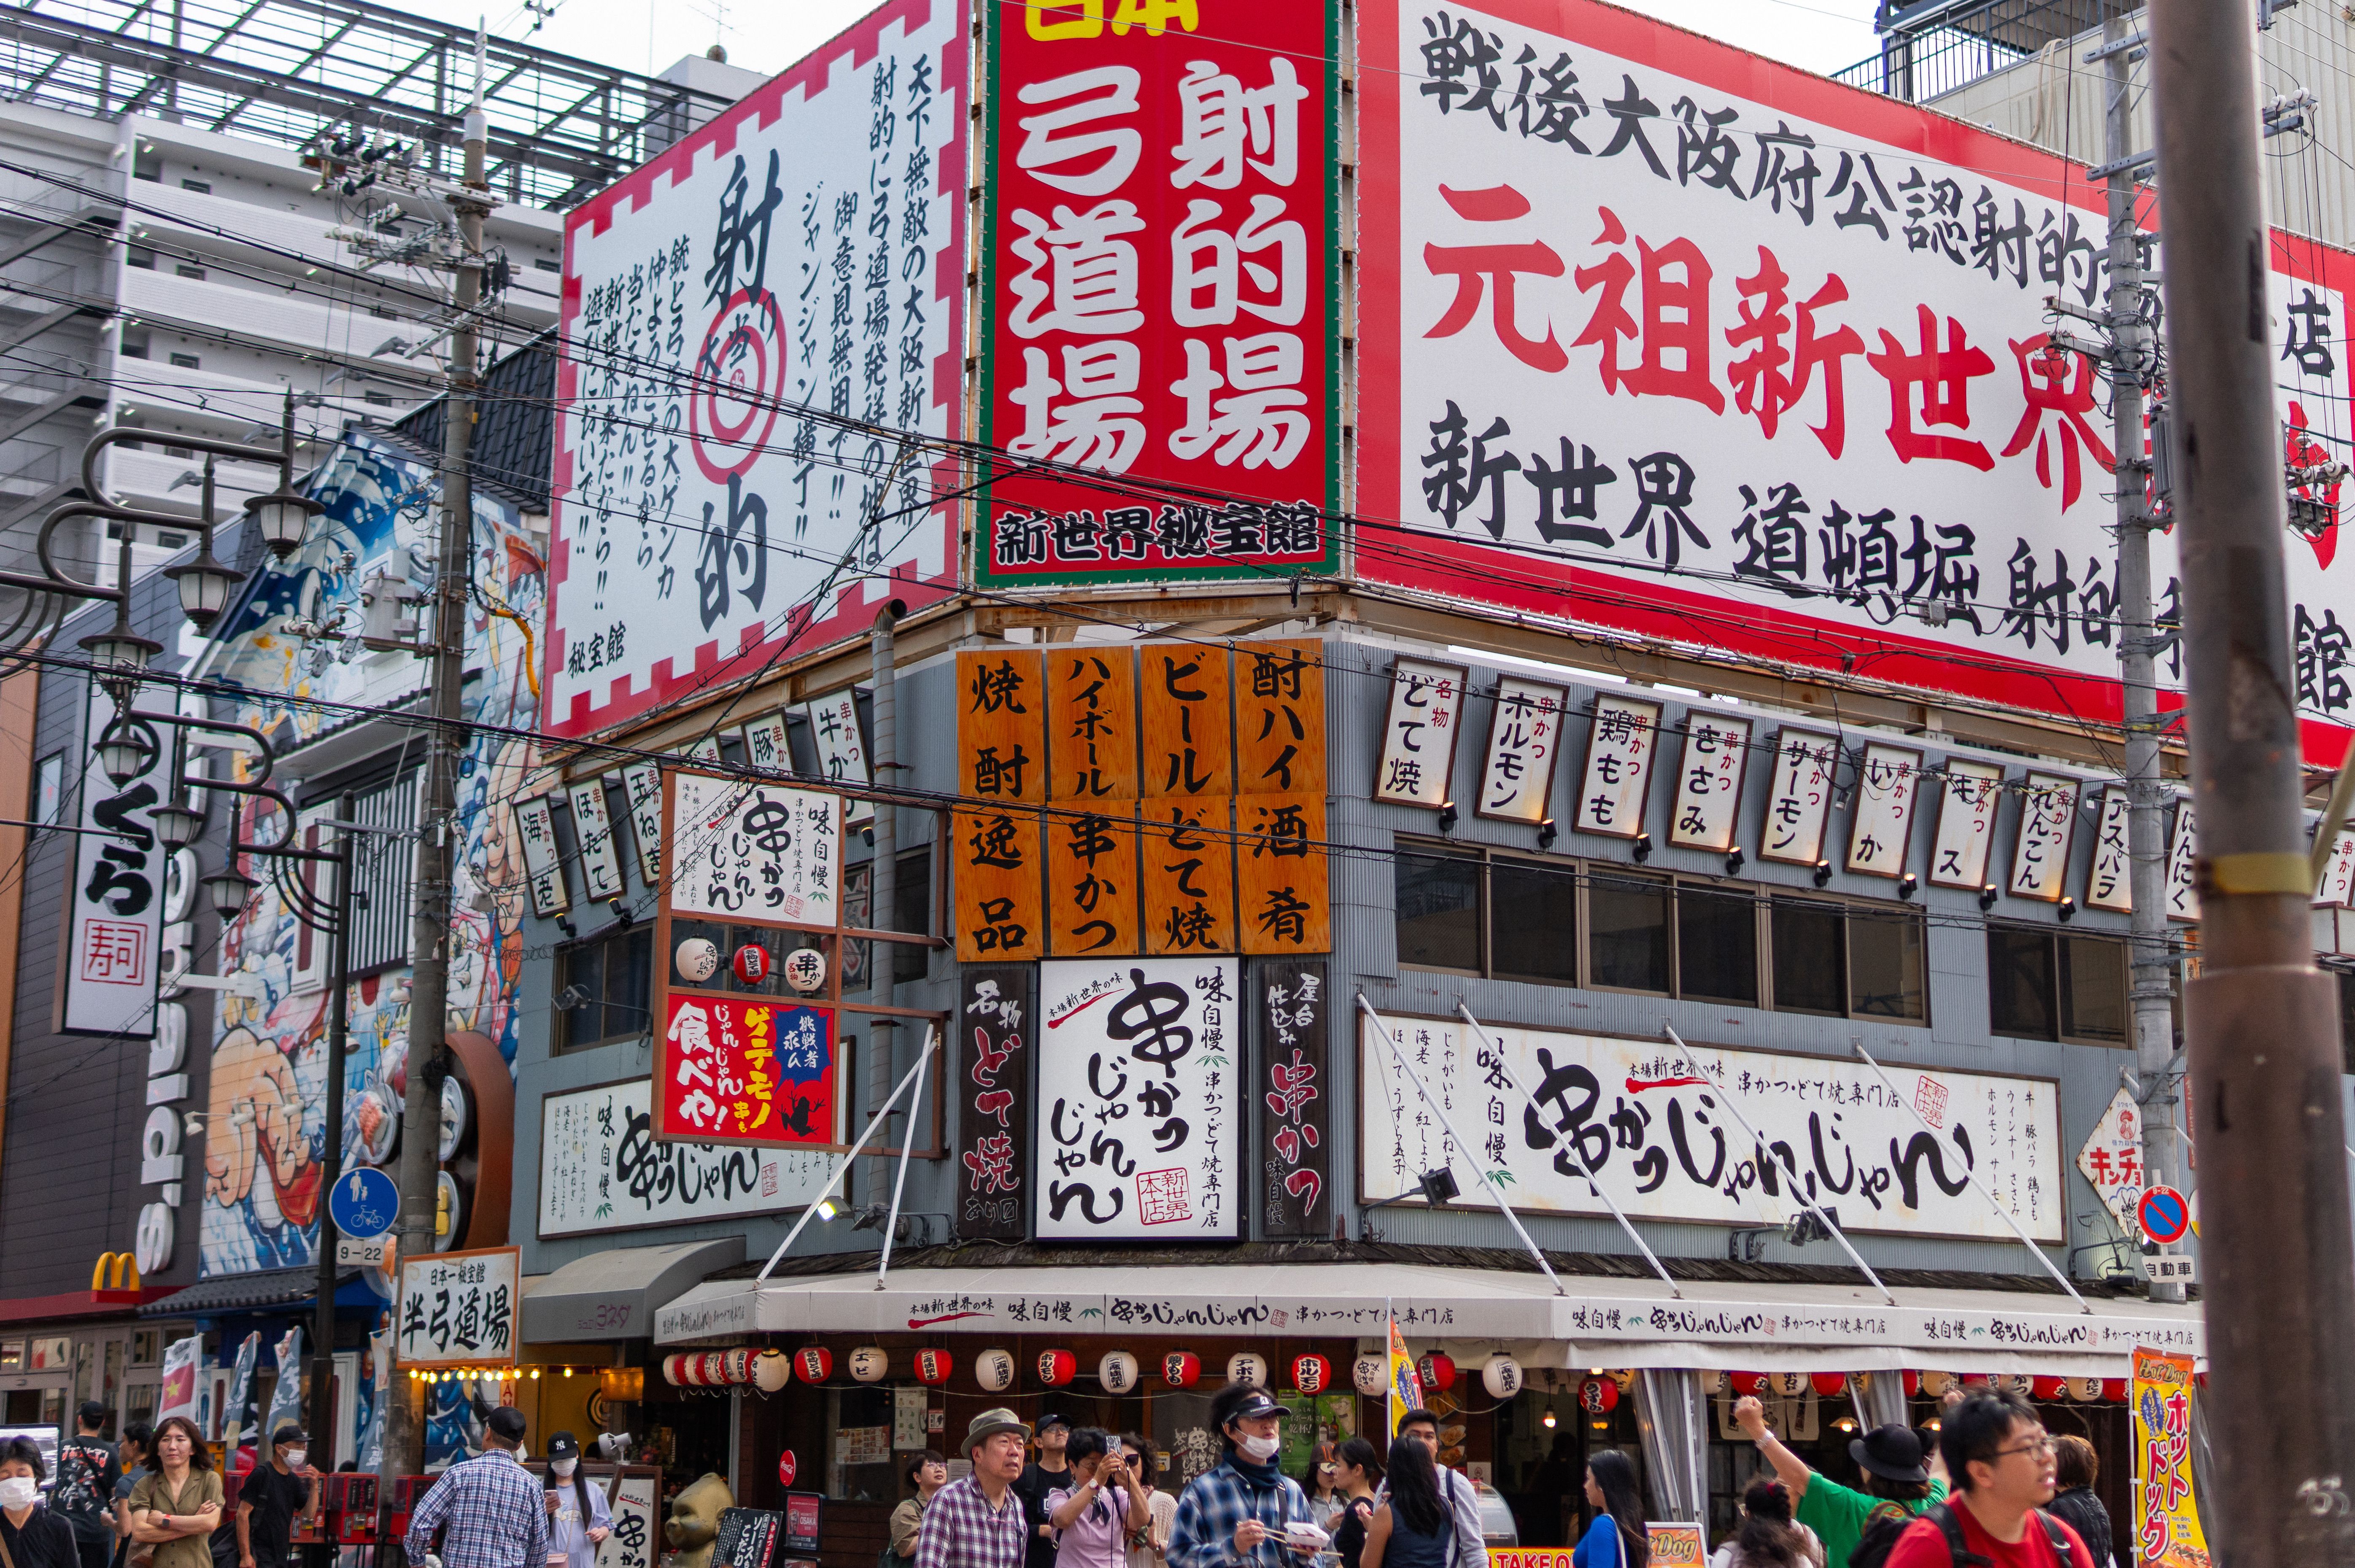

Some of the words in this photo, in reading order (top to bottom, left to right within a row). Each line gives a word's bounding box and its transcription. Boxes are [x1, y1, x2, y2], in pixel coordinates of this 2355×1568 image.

[1009, 65, 1146, 475] 弓道場
[1168, 56, 1310, 471] 射的場
[995, 501, 1320, 565] 新世界秘宝館
[1422, 399, 1711, 577] 新世界
[1731, 482, 1980, 636] 道頓堀
[568, 620, 625, 679] 秘宝館
[840, 701, 859, 762] 串かつ
[971, 660, 1029, 798] 焼酎
[1067, 656, 1116, 797] ハイボール
[1164, 651, 1213, 794] ビール
[1252, 650, 1307, 791] 酎ハイ
[1432, 679, 1453, 728] 名物
[1532, 696, 1554, 759] 串かつ
[1385, 675, 1434, 795] どて焼
[1490, 692, 1535, 808] ホルモン
[1627, 714, 1647, 776] 串かつ
[1718, 730, 1738, 791] 串かつ
[1590, 709, 1632, 825] 鶏もも
[1680, 725, 1720, 835] ささみ
[1772, 741, 1811, 849] サーモン
[1808, 749, 1828, 806] 串かつ
[1892, 761, 1910, 819] 串かつ
[540, 809, 555, 860] 串かつ
[1856, 759, 1892, 862] いか
[1939, 775, 1974, 877] キス
[1973, 776, 1992, 832] 串かつ
[2052, 789, 2069, 844] 串かつ
[85, 781, 159, 916] くら
[523, 813, 553, 907] 海老
[576, 792, 608, 889] ほたて
[732, 832, 755, 897] じゃん
[742, 791, 791, 907] 串かつ
[809, 802, 835, 889] 味自慢
[2018, 786, 2053, 889] れんこん
[2096, 798, 2128, 899] アスパラ
[2172, 810, 2197, 911] にんにく
[2337, 840, 2353, 890] 串かつ
[708, 843, 742, 911] じゃん
[969, 813, 1028, 953] 逸品
[1067, 811, 1117, 953] 串かつ
[1164, 806, 1219, 951] どて焼
[1253, 803, 1311, 945] 酒肴
[88, 924, 140, 978] 寿司
[788, 962, 798, 981] 名物
[796, 953, 820, 986] 串かつ
[967, 980, 1021, 1029] 名物
[1049, 972, 1122, 1018] 本場新世界の味
[1195, 966, 1232, 1052] 味自慢
[1268, 985, 1297, 1044] 仕込み
[1293, 973, 1320, 1026] 屋台
[715, 1005, 743, 1096] じゃんじゃん
[745, 1006, 773, 1129] ゲテモノ
[784, 1031, 801, 1068] 求ム
[799, 1016, 819, 1068] 挑戦者
[1106, 968, 1194, 1153] 串かつ
[1416, 1029, 1431, 1064] 海老
[1443, 1032, 1454, 1110] じゃがいも
[734, 1101, 750, 1133] 串も
[963, 1026, 1021, 1194] どて焼
[1088, 1052, 1136, 1177] じゃん
[1477, 1037, 1513, 1166] 味自慢
[1737, 1070, 1900, 1108] 串かつ・どて焼専門店
[1928, 1085, 1948, 1125] 新世界
[1987, 1088, 1998, 1146] ホルモン
[2025, 1090, 2035, 1107] 牛
[597, 1095, 615, 1199] 味自慢
[1201, 1071, 1223, 1228] 串かつ・どて焼専門店
[1266, 1049, 1320, 1216] 串かつ
[1523, 1048, 1975, 1211] 串かつじゃんじゃん
[2007, 1090, 2017, 1160] ウィンナー
[2026, 1124, 2037, 1168] 豚バラ
[1049, 1097, 1124, 1224] じゃん
[2090, 1147, 2144, 1185] キンチョ
[1140, 1174, 1164, 1222] 本店
[1161, 1170, 1191, 1221] 新世界
[1266, 1158, 1285, 1226] 味自慢
[2010, 1173, 2020, 1216] ささみ
[2028, 1178, 2039, 1220] 鶏もも
[430, 1262, 486, 1286] 日本一秘宝館
[2146, 1262, 2192, 1275] 自動車
[401, 1284, 510, 1354] 半弓道場
[910, 1296, 994, 1315] 本場新世界の味
[1008, 1298, 1073, 1323] 味自慢
[1111, 1298, 1269, 1326] 串かつじゃんじゃん
[1573, 1305, 1622, 1331] 味自慢
[1650, 1307, 1763, 1335] 串かつじゃんじゃん
[1924, 1317, 1966, 1340] 味自慢
[1991, 1318, 2086, 1344] 串かつじゃんじゃん
[855, 1352, 869, 1375] エビ
[1040, 1353, 1055, 1382] ホルモン
[1300, 1358, 1320, 1391] ホルモン
[2139, 1359, 2164, 1380] Hot
[2164, 1364, 2188, 1388] Dog
[1289, 1424, 1312, 1433] 乾杯!
[2165, 1390, 2190, 1511] ホット
[2141, 1439, 2169, 1560] ドッグ
[614, 1509, 646, 1568] 串かつ
[1496, 1552, 1553, 1568] TAKE
[1657, 1532, 1697, 1562] Dog
